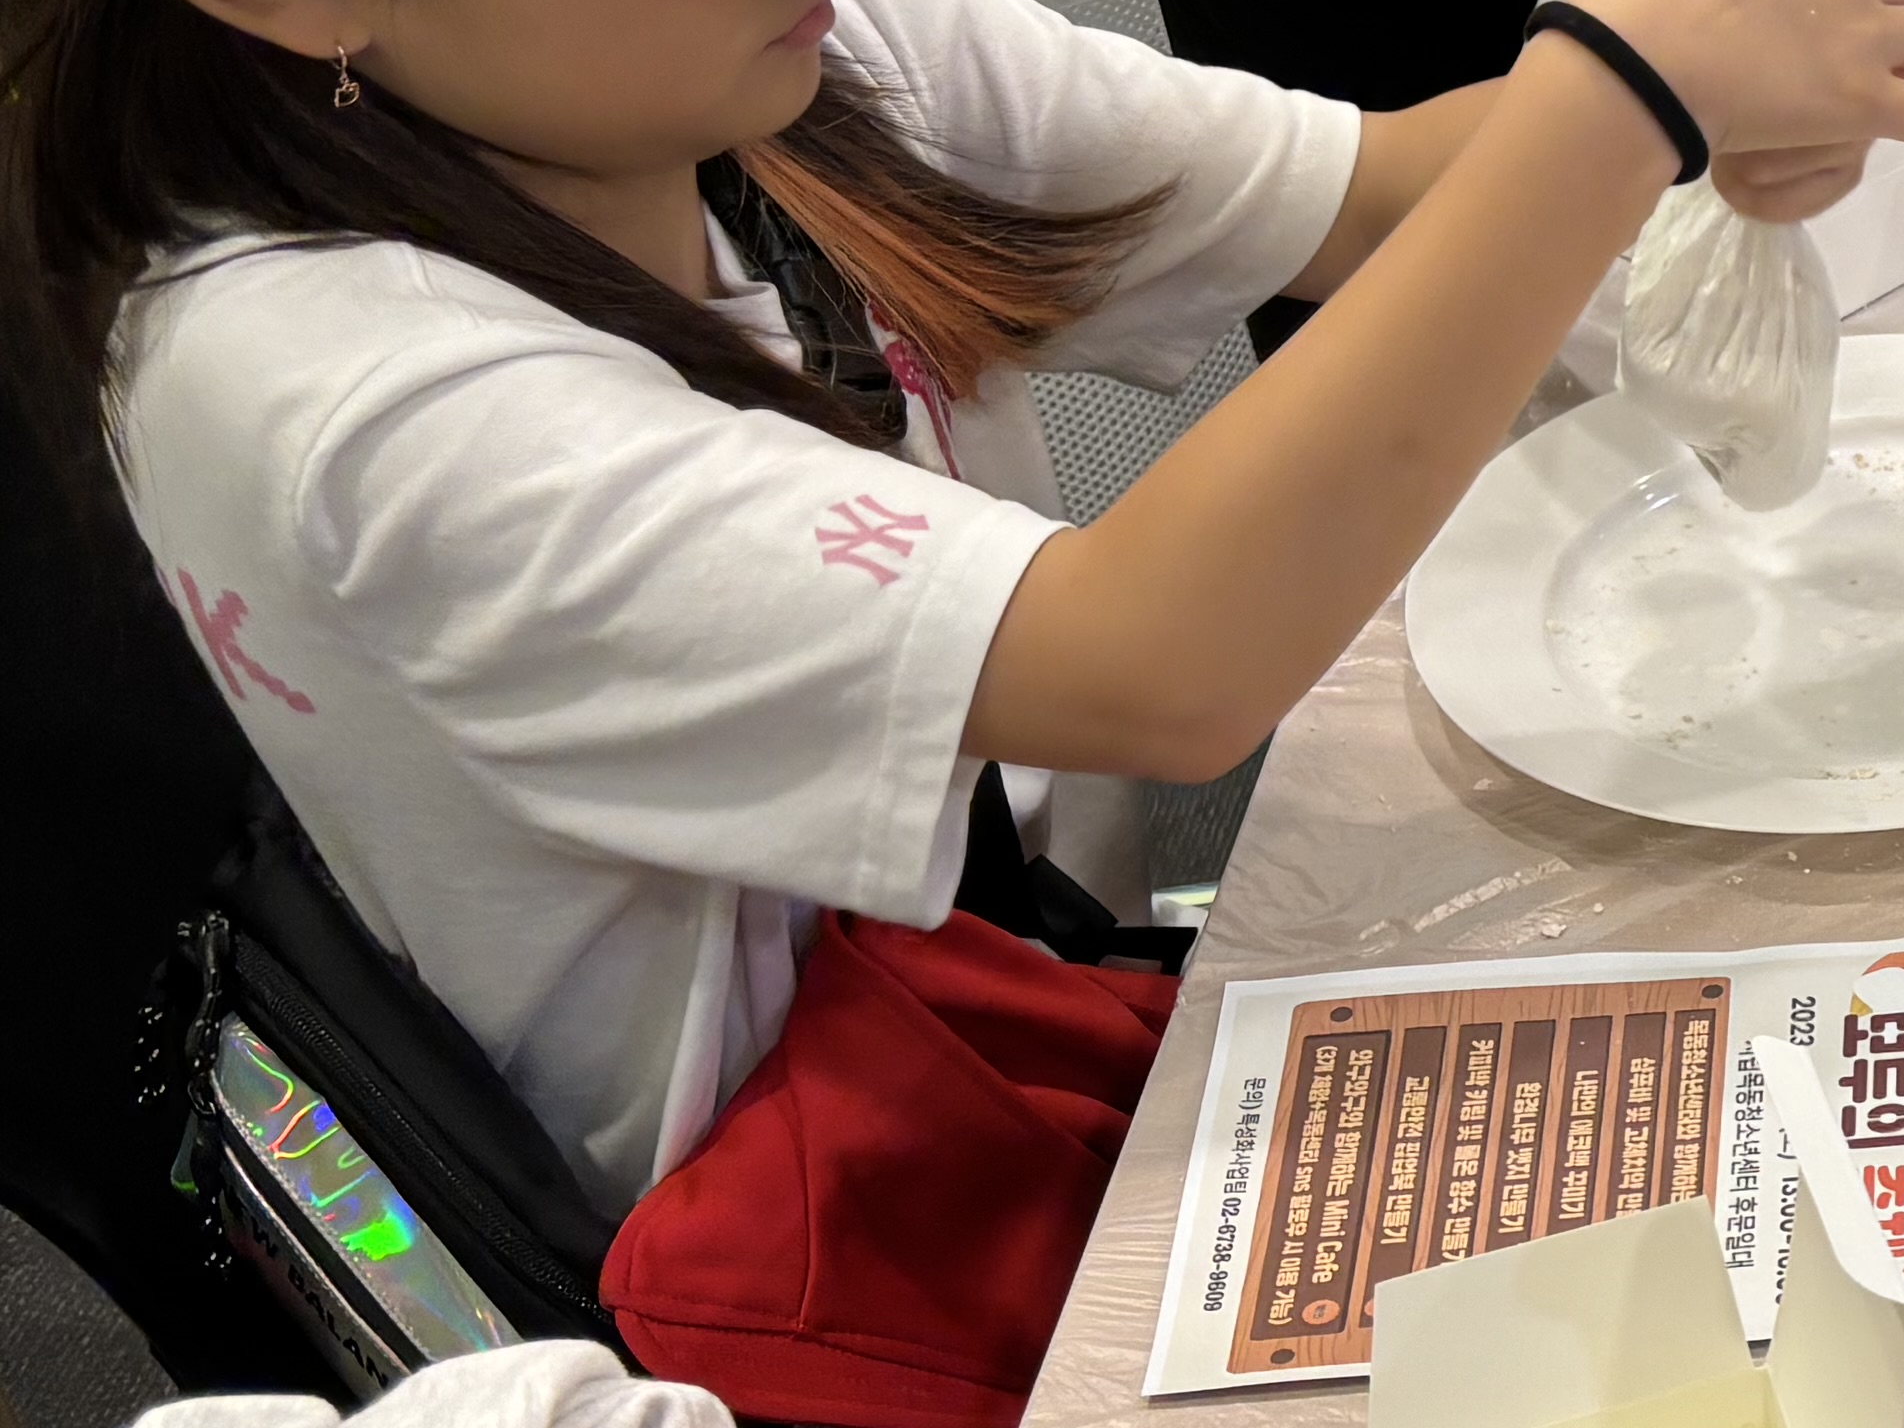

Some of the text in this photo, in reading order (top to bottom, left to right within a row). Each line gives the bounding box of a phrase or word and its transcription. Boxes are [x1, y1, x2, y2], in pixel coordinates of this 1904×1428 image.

[1337, 1049, 1373, 1128] 와구와구와
[1464, 1040, 1495, 1087] 커피박
[1675, 1020, 1709, 1140] 목동청소년센터와
[1456, 1125, 1484, 1140] 및
[1459, 1089, 1488, 1121] 키링
[1510, 1082, 1542, 1145] 환경나무
[1625, 1106, 1651, 1123] 및
[1326, 1131, 1362, 1197] 함께하는
[1381, 1076, 1430, 1244] 교통안전 팝업북 만들기
[1558, 1071, 1599, 1220] 나만의 에코백 꾸미기
[1618, 1127, 1649, 1189] 고체치약
[1203, 1077, 1267, 1312] 문의) 특성화사업팀 02-6738-9609
[1267, 1045, 1339, 1325] (3개 체험+목동센터 sns 팔로우 시 이용 가능)
[1446, 1180, 1477, 1214] 향수
[1497, 1184, 1529, 1233] 만들기
[1318, 1200, 1350, 1237] Mini
[1725, 1196, 1756, 1269] 후문일대
[1311, 1241, 1342, 1284] Cafe
